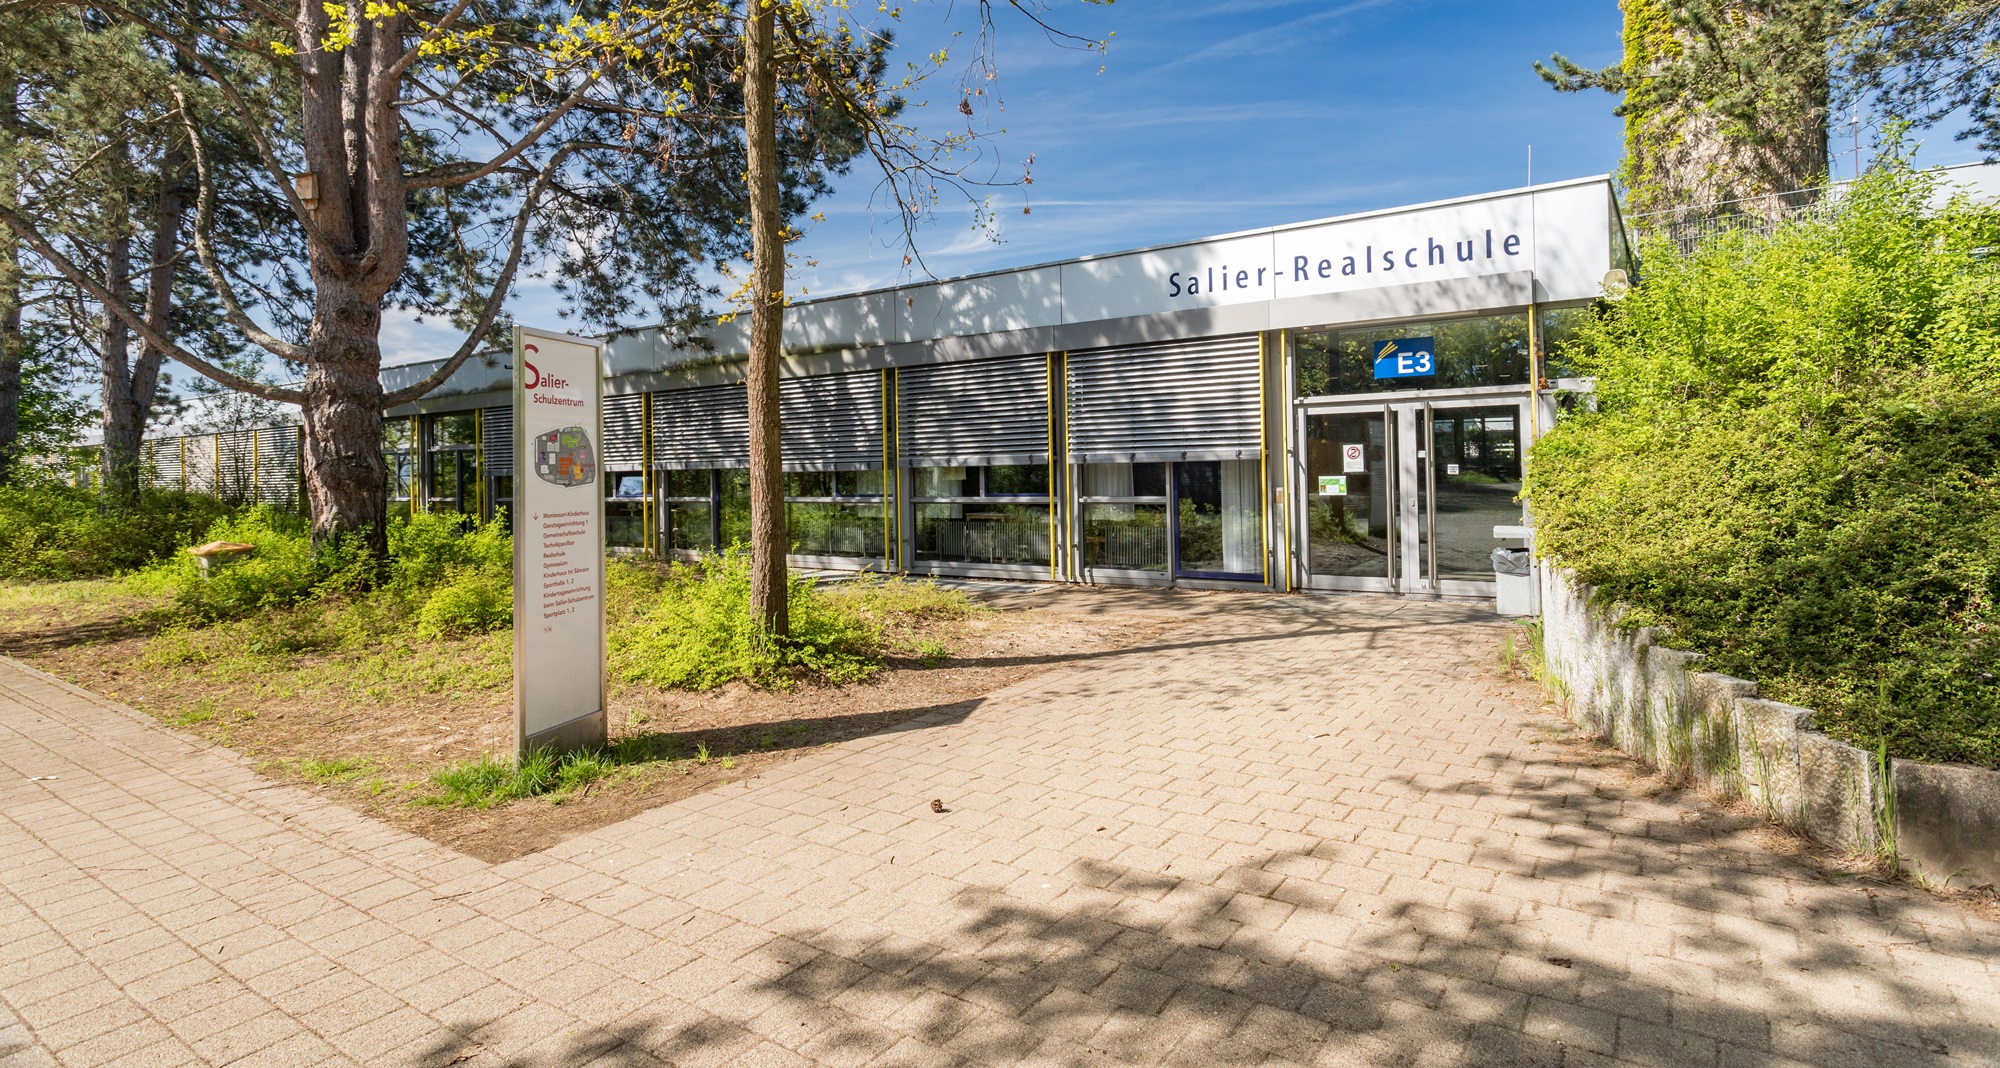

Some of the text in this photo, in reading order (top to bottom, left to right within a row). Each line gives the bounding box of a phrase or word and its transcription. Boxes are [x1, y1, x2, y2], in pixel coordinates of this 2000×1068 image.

[1169, 229, 1521, 297] Salier-Realschule
[525, 343, 569, 390] Salier-
[1397, 351, 1431, 374] E3
[533, 393, 584, 407] Schulzentrum
[544, 530, 585, 538] Gemeinschaftsschule
[544, 561, 568, 569] Gymnasium
[544, 580, 565, 589] Sporthalle
[555, 595, 594, 606] Salier-Schulzentrum
[544, 610, 566, 619] Sportplatz
